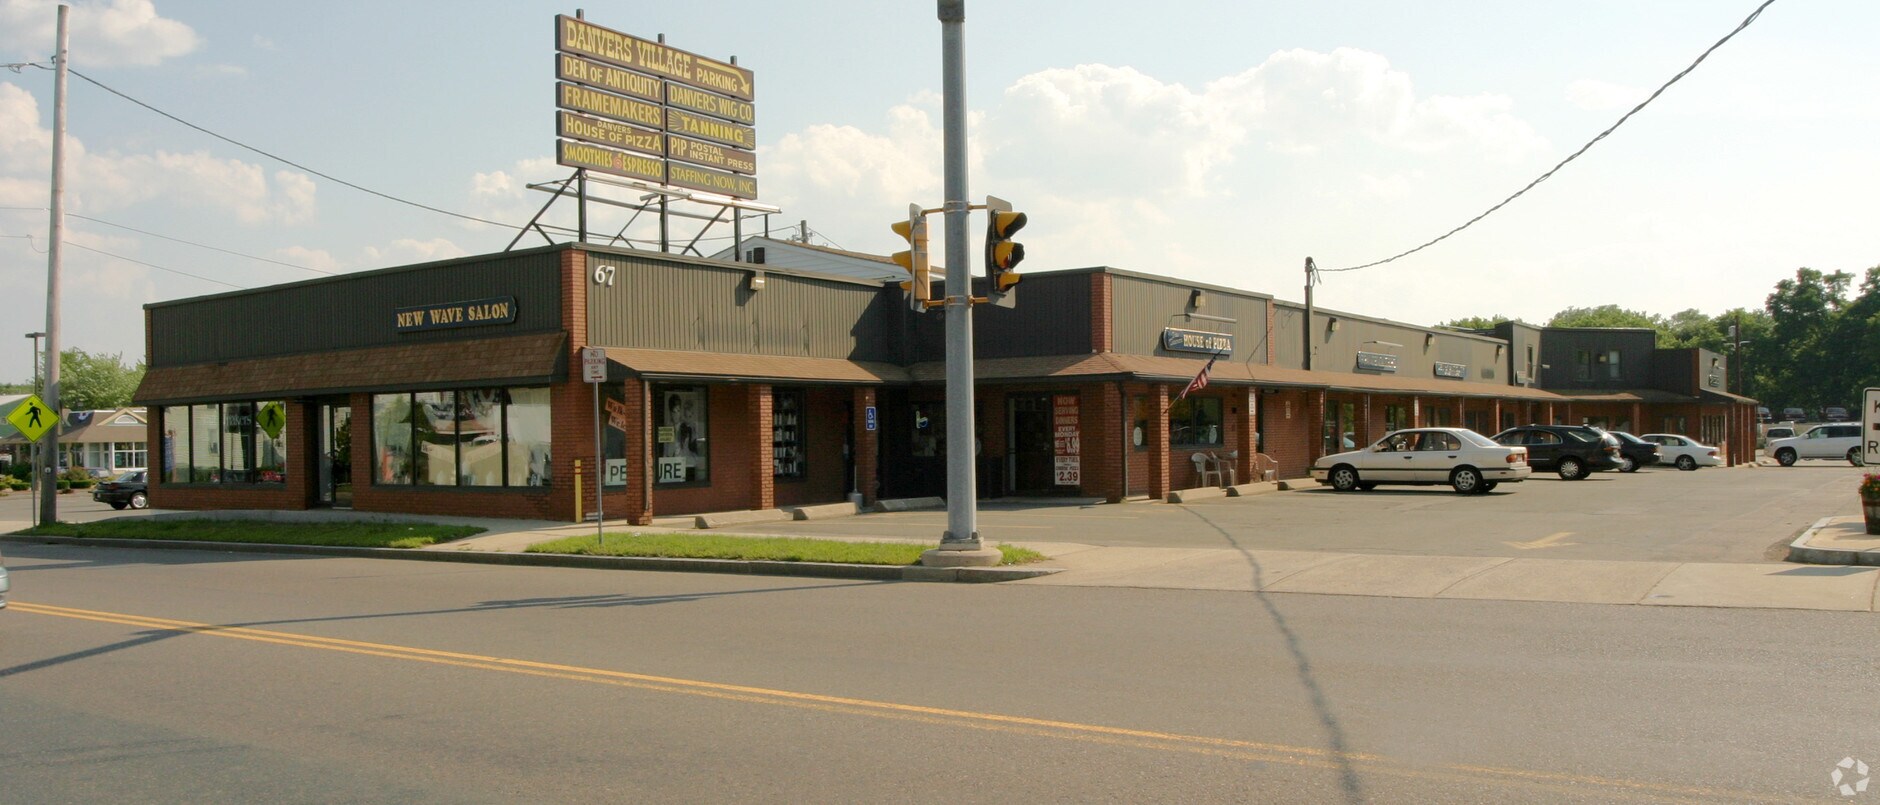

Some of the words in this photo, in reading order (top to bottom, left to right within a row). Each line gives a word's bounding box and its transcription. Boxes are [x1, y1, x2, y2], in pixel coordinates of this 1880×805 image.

[566, 20, 632, 63] DANVERS
[636, 41, 691, 80] VILLAGE
[564, 56, 587, 80] DEN
[590, 66, 603, 83] OF
[605, 67, 660, 98] ANTIQUITY
[696, 67, 738, 92] PARKING
[564, 85, 660, 125] FRAMEMAKERS
[670, 85, 716, 112] DANVERS
[718, 97, 738, 117] WIG
[565, 113, 605, 140] HOUSE
[608, 131, 623, 143] OF
[625, 134, 662, 152] PIZZA
[597, 120, 632, 134] DANVERS
[681, 116, 744, 143] TANNING
[670, 136, 687, 157] PIP
[690, 141, 723, 156] POSTAL
[564, 143, 613, 168] SMOOTHIES
[622, 154, 662, 177] ESPRESSO
[689, 149, 725, 165] INSTANT
[727, 158, 754, 171] PRESS
[670, 166, 711, 186] STAFFING
[594, 264, 615, 286] 67
[396, 310, 425, 328] NEW
[429, 307, 463, 325] WAVE
[468, 302, 509, 321] SALON
[1183, 334, 1204, 348] HOUSE
[1213, 337, 1232, 350] PIZZA
[1057, 396, 1075, 406] NOW
